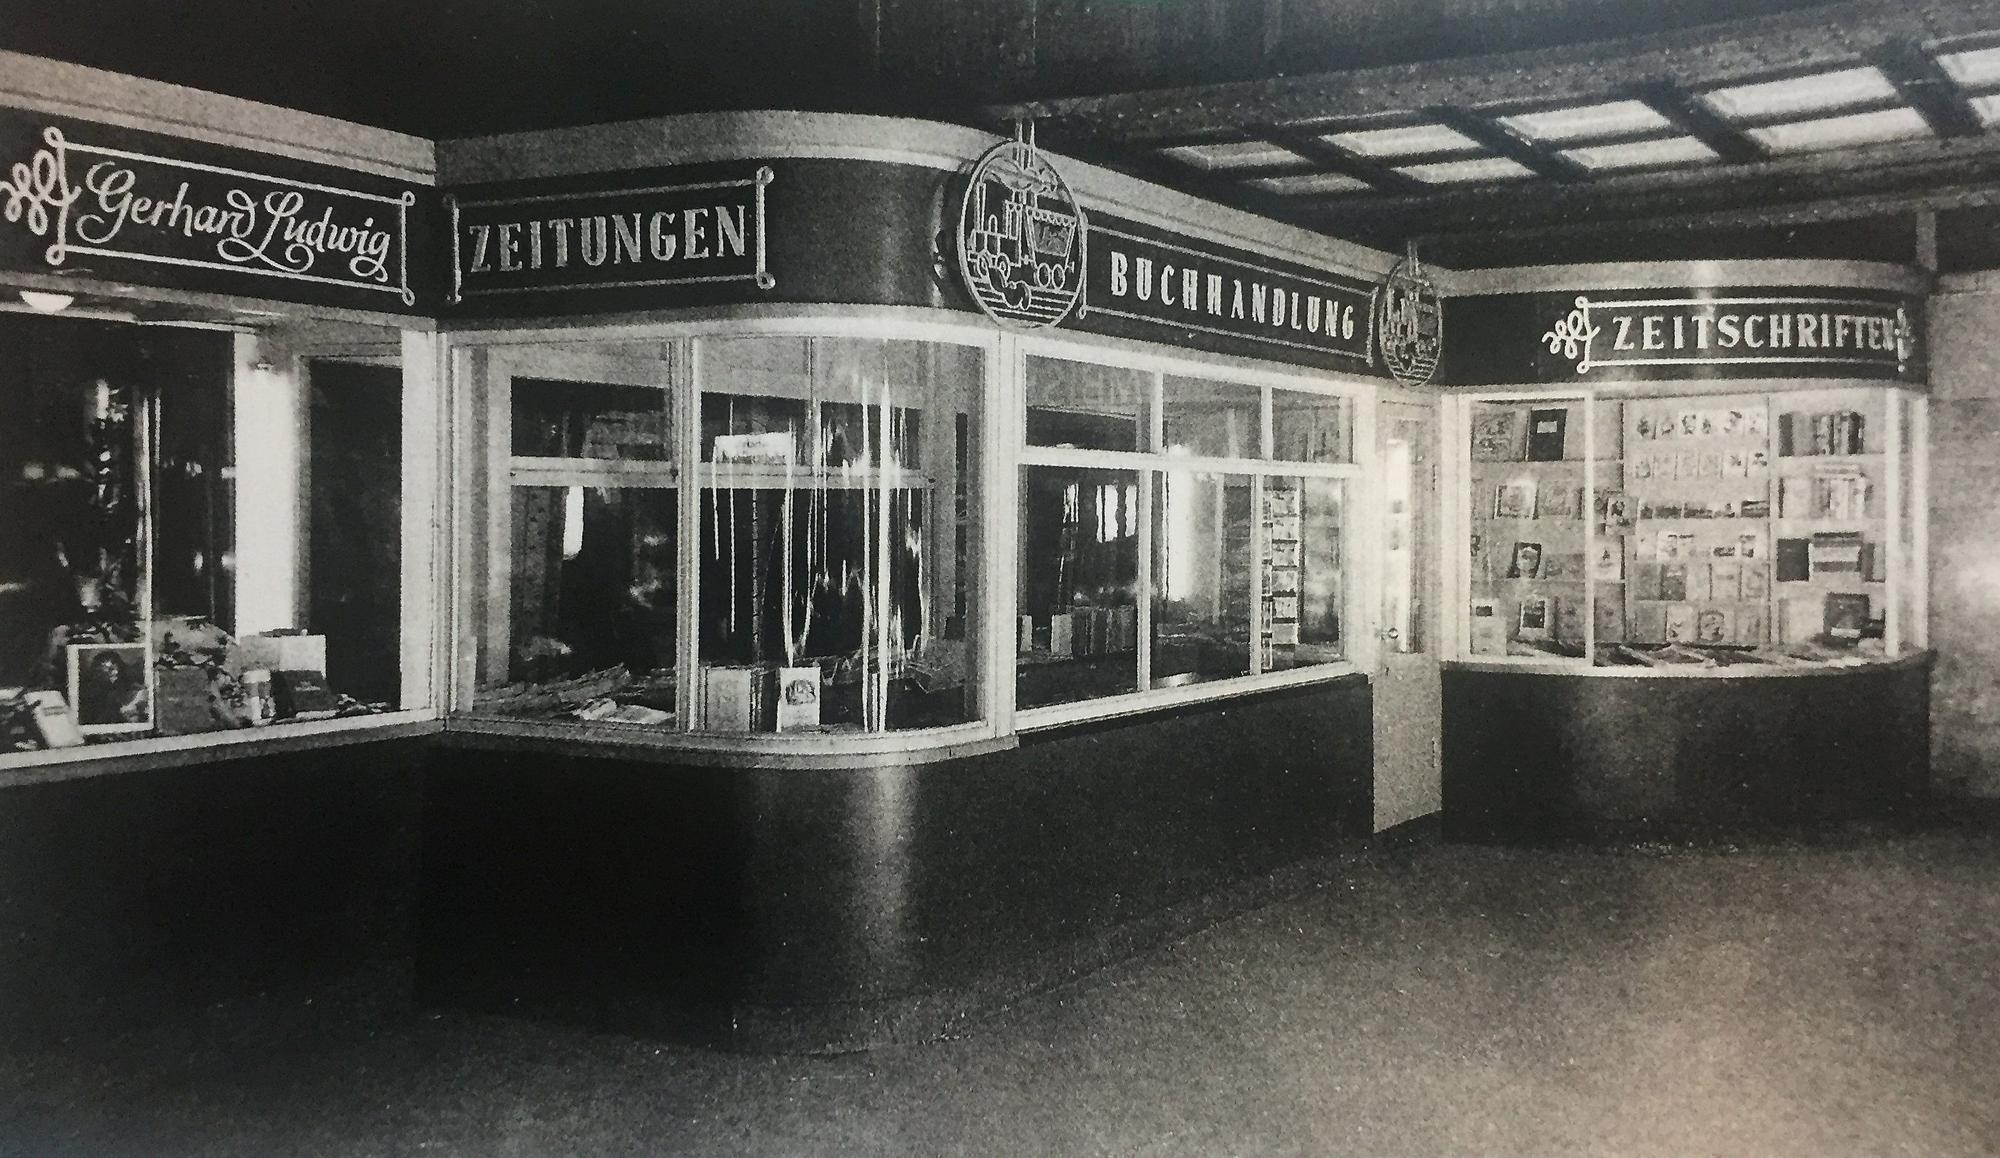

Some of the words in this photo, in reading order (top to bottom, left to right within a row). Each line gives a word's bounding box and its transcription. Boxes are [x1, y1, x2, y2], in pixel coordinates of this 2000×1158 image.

[76, 161, 256, 244] Gerhard
[216, 190, 391, 282] Ludwig
[469, 205, 746, 273] ZEITUNGEN
[1111, 251, 1355, 340] BUCHHANDLUNG
[1612, 314, 1895, 351] ZEITSCHRIFTEN
